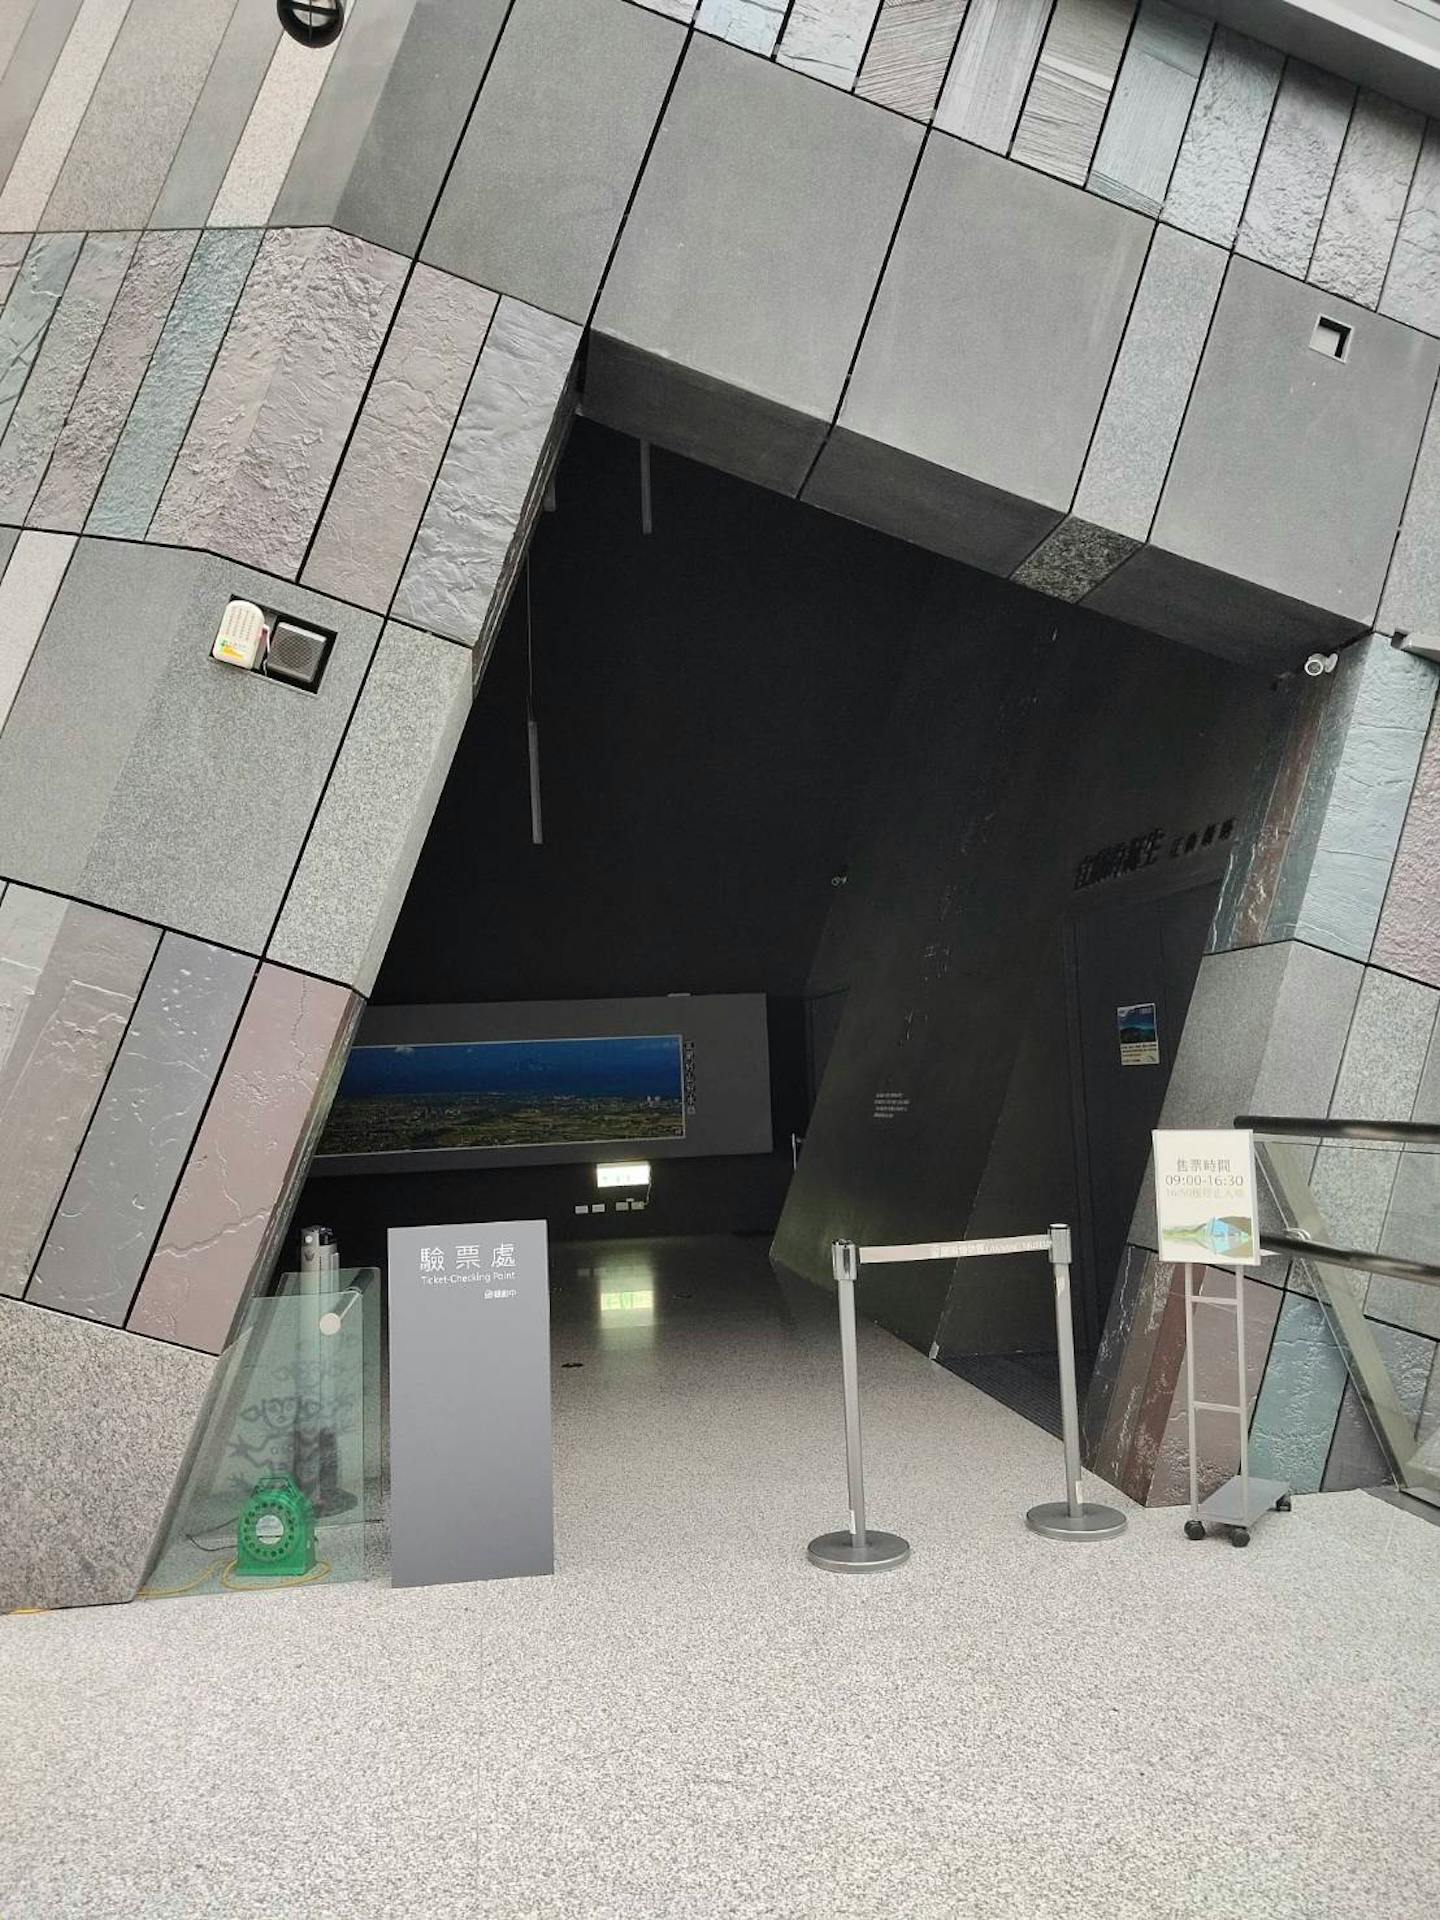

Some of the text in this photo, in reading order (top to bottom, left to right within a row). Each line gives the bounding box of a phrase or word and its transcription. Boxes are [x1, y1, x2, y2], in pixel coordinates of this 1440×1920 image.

[1177, 1157, 1231, 1173] 售票時間
[1165, 1174, 1244, 1187] 09:00-16:30
[420, 1243, 517, 1272] 驗票處
[421, 1271, 516, 1285] Ticket-Checking Point
